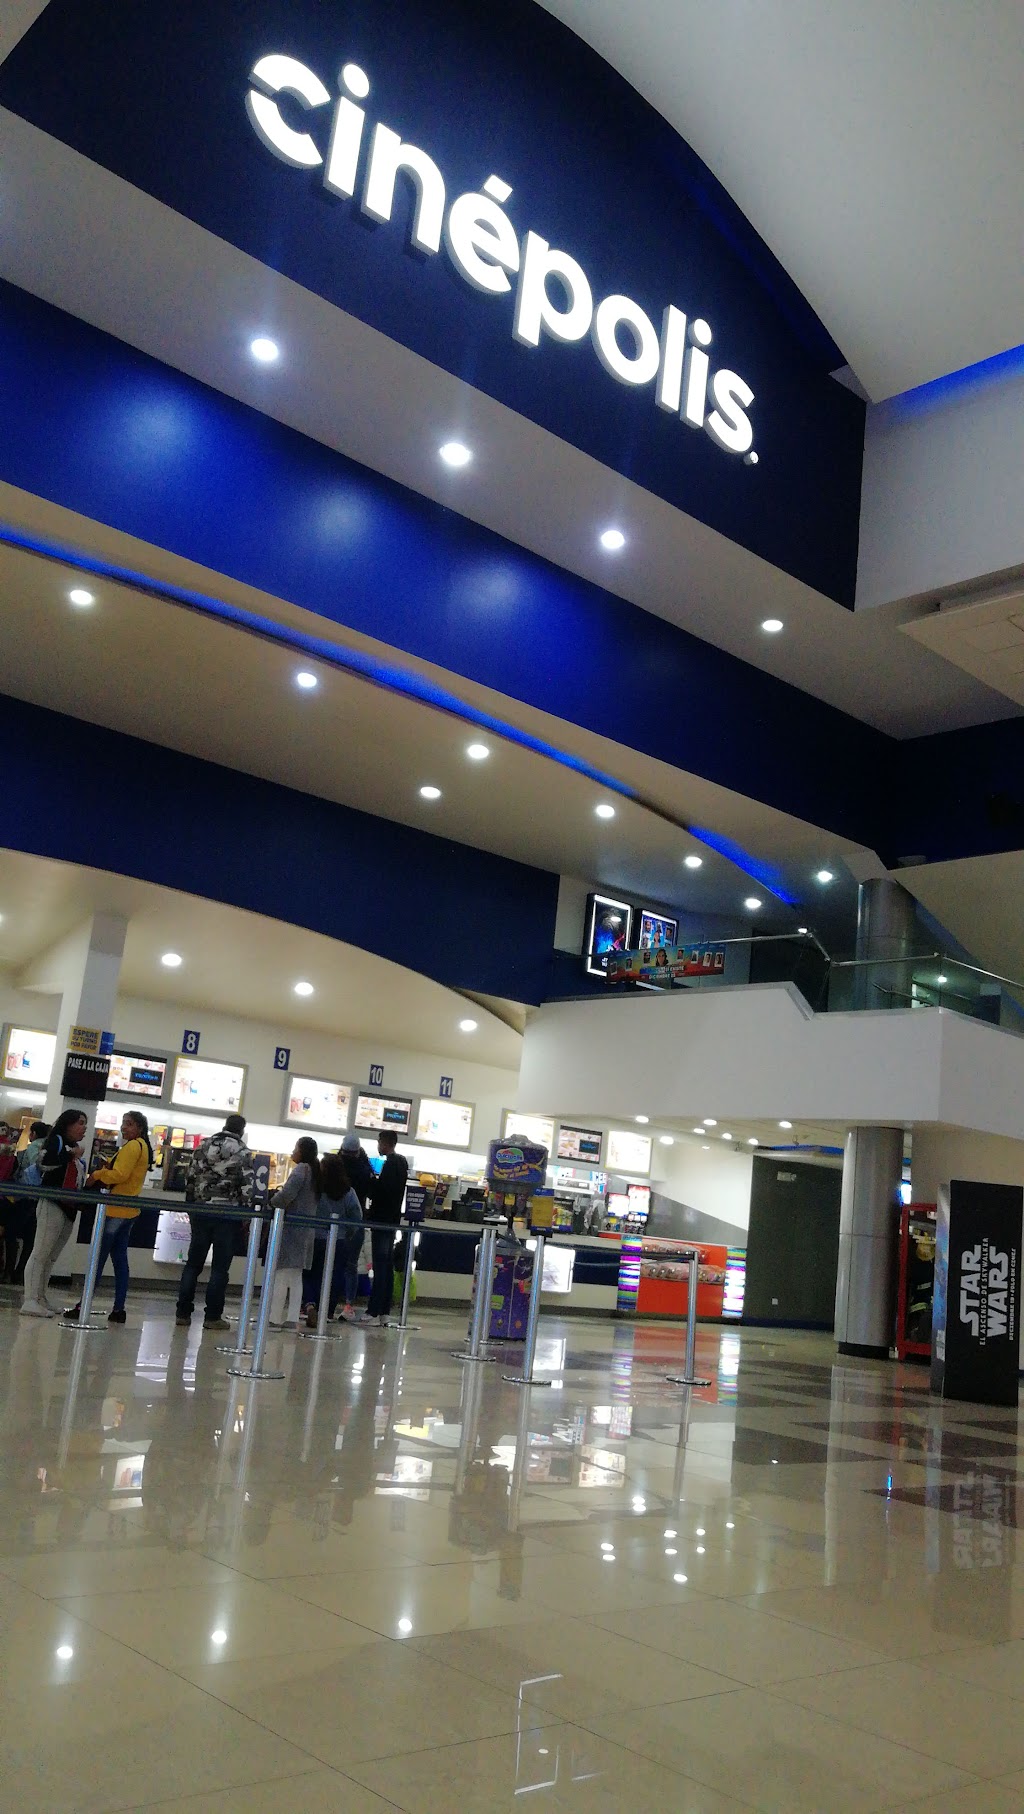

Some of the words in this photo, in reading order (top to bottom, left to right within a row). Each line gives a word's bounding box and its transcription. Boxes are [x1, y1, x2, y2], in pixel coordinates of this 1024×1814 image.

[73, 1029, 99, 1039] ESPERE
[185, 1032, 197, 1051] 8
[68, 1057, 82, 1069] PASE
[82, 1060, 87, 1070] A
[87, 1061, 95, 1071] LA
[95, 1062, 109, 1073] CAJA
[277, 1050, 287, 1067] 9
[370, 1067, 383, 1084] 10
[441, 1080, 452, 1095] 11
[981, 1237, 989, 1283] SKYWALKER
[1010, 1268, 1016, 1277] EN
[959, 1244, 982, 1337] STAR
[981, 1285, 988, 1295] DE
[987, 1245, 1009, 1338] WARS
[979, 1337, 986, 1346] EL
